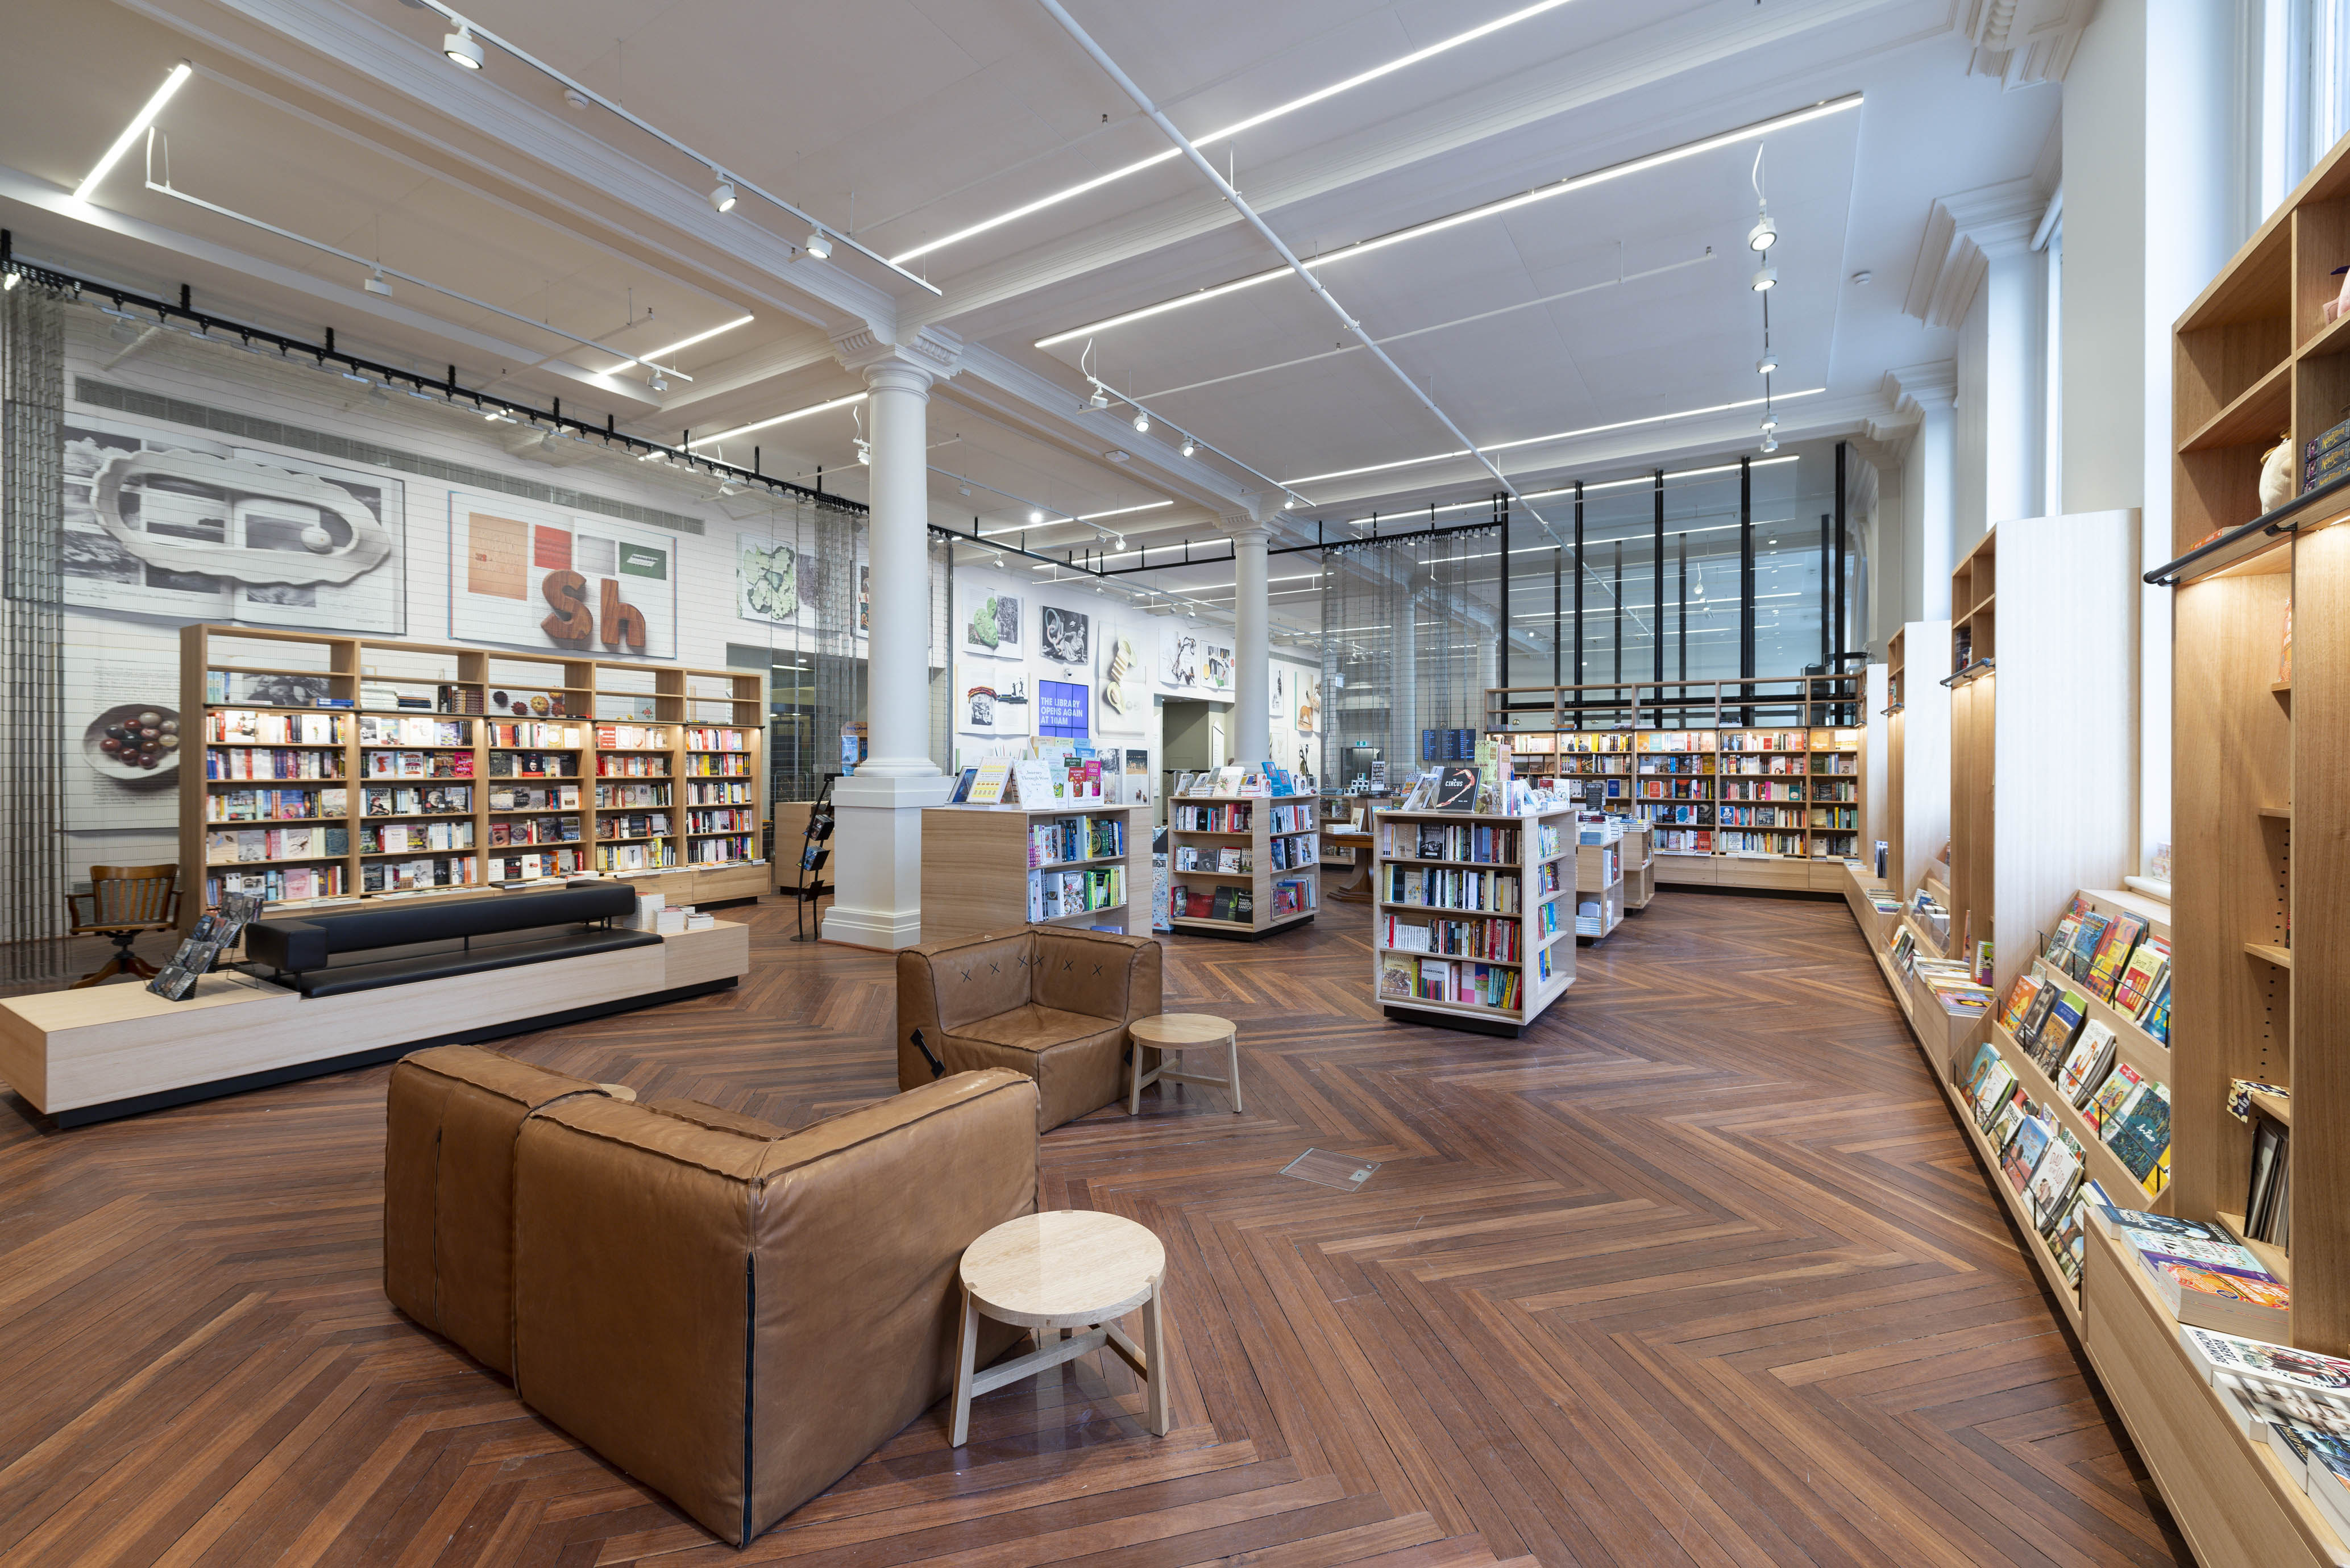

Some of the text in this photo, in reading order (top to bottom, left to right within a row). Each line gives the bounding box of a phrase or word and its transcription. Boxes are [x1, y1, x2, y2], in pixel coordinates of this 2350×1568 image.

[1041, 697, 1080, 709] THE LIBRARY
[1041, 706, 1083, 718] OPENS AGAIN
[1040, 716, 1068, 725] AT 10AM
[2133, 954, 2156, 974] Dear Zoo
[2192, 1329, 2231, 1365] MUCHAMORE
[2211, 1338, 2240, 1363] ROBERT
[2280, 1425, 2302, 1444] PHILIP
